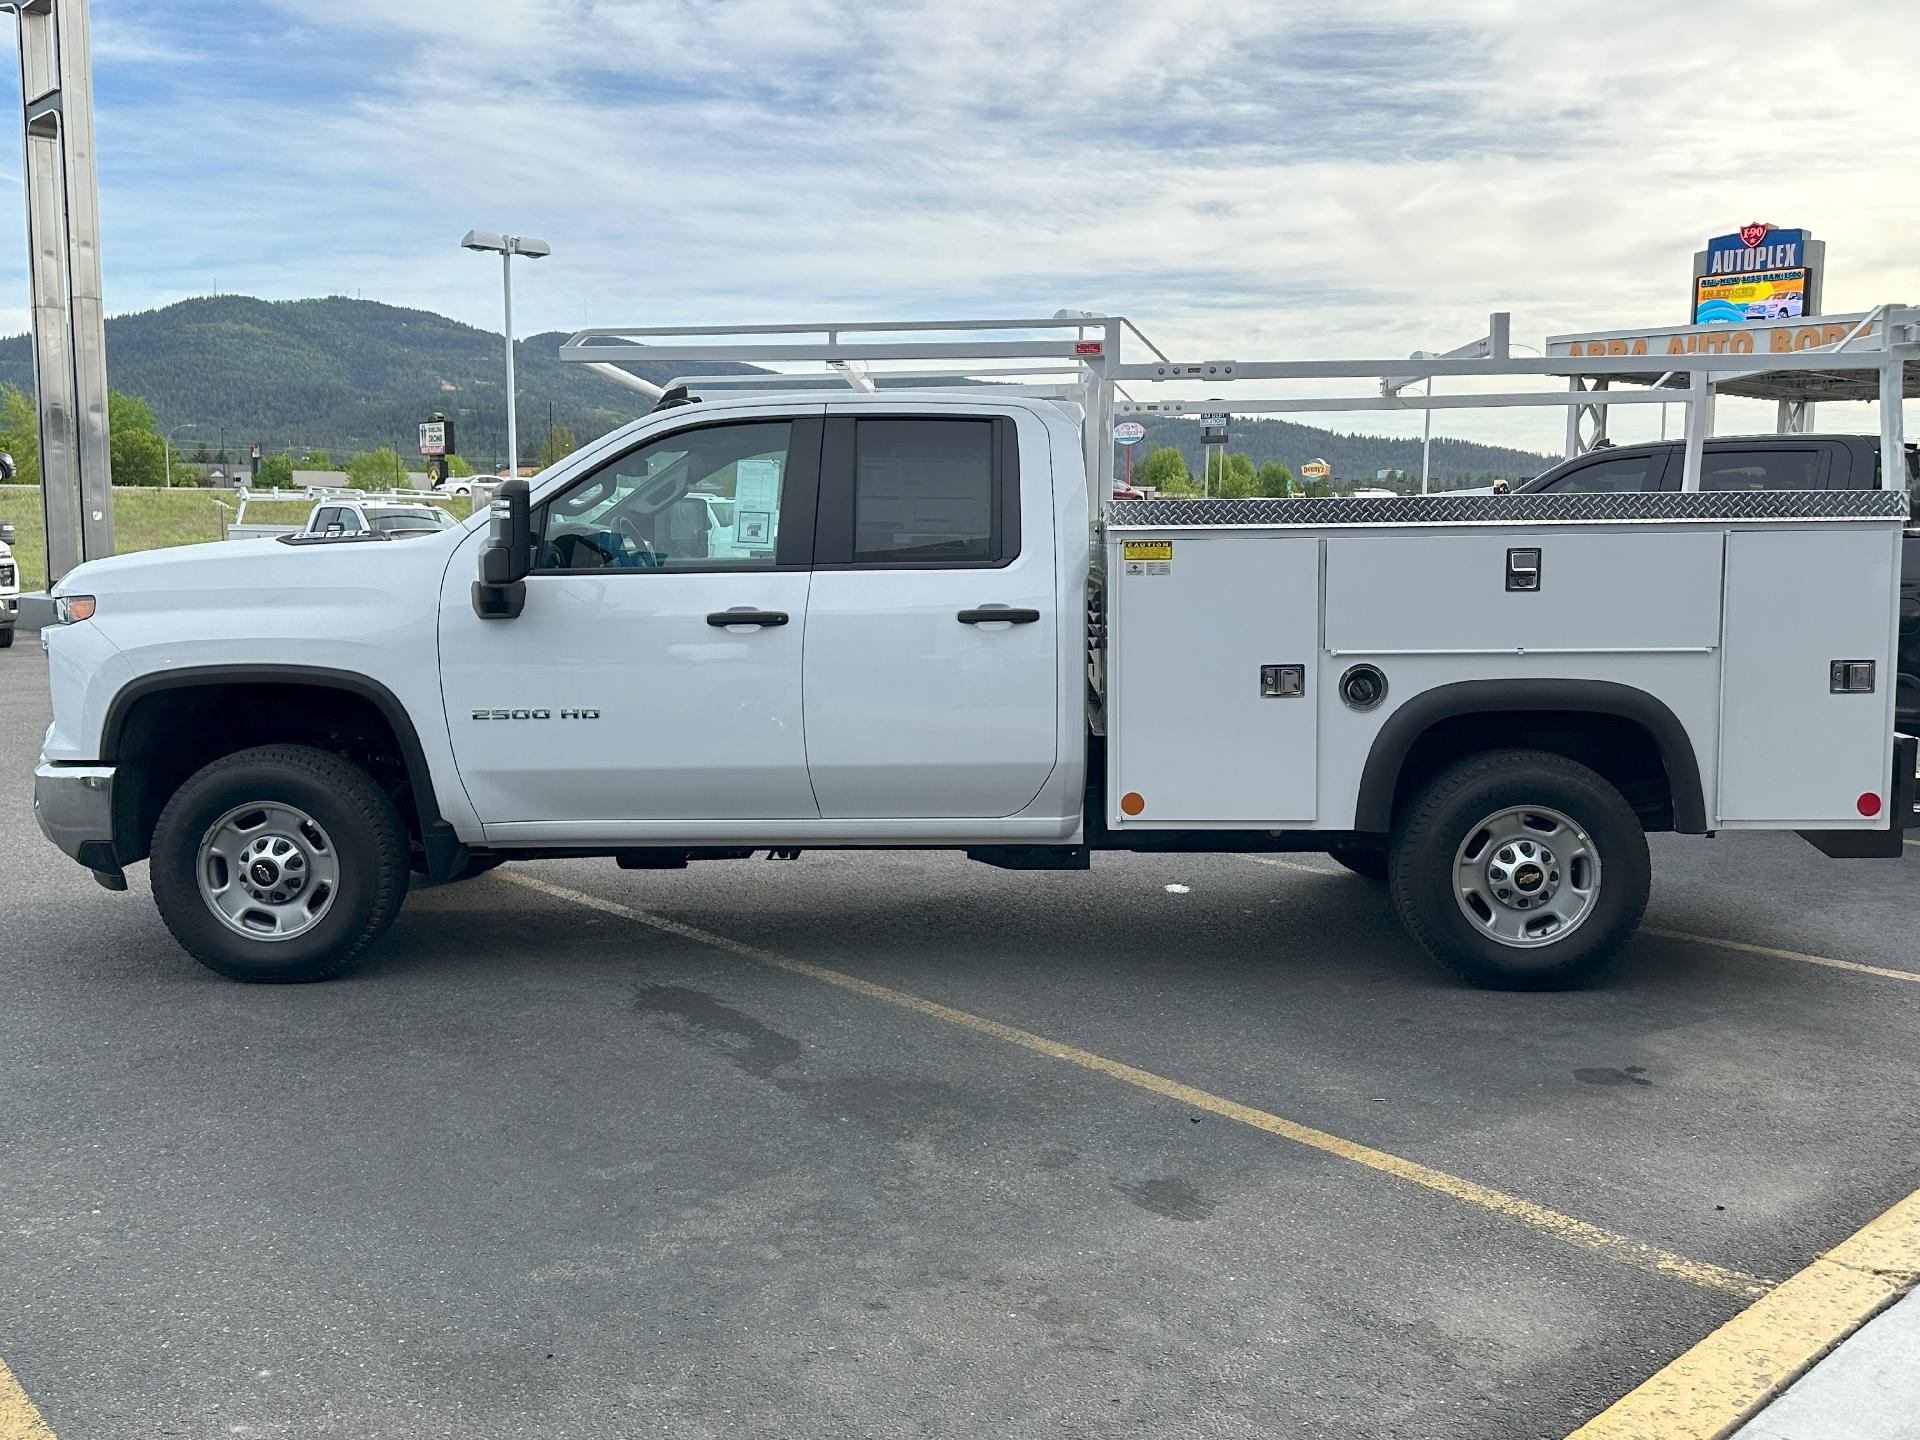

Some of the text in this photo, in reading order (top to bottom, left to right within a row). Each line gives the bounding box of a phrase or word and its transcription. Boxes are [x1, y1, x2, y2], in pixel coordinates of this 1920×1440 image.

[1711, 243, 1796, 274] AUTOPLEX
[1665, 331, 1753, 354] AUTO
[1303, 465, 1325, 474] Denny's
[471, 709, 600, 720] 2500 HD
